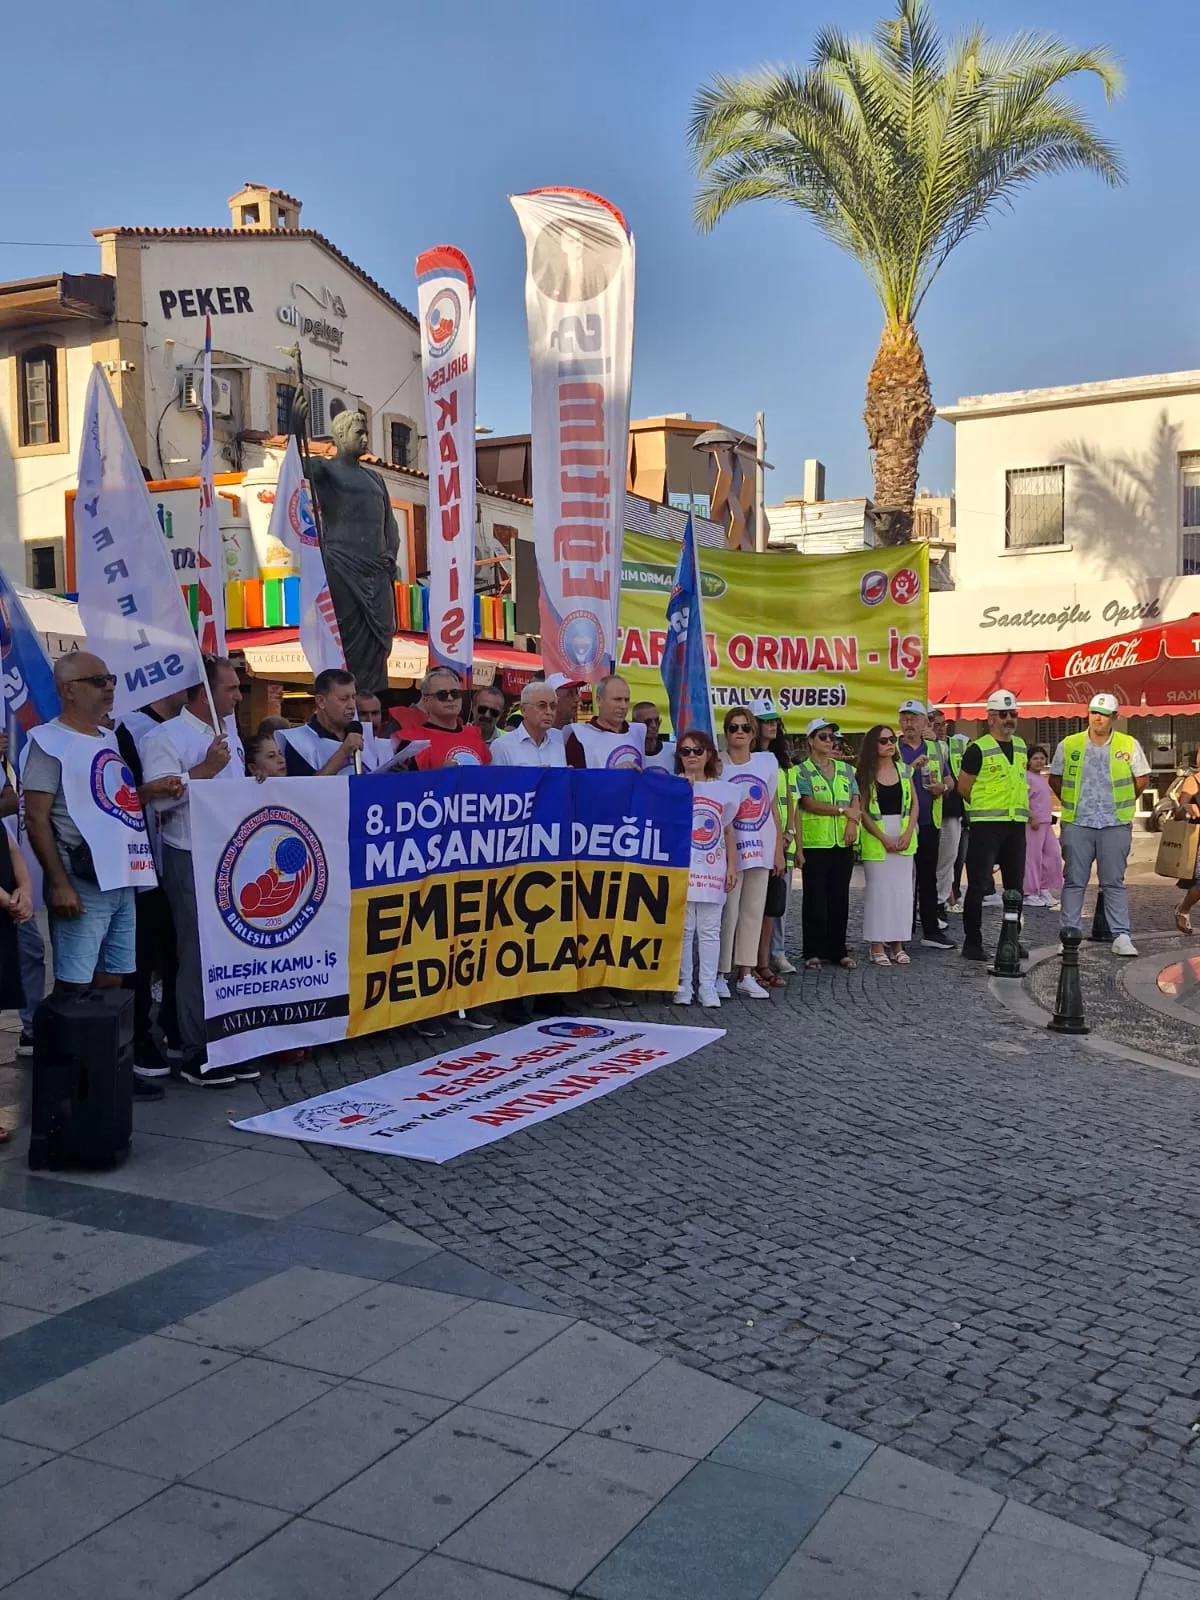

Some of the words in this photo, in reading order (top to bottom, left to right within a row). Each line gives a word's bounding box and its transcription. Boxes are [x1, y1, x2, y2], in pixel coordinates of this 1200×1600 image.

[159, 286, 254, 320] PEKER
[279, 304, 299, 328] ali
[301, 317, 345, 346] peker
[640, 571, 673, 587] ORMA
[1102, 598, 1160, 627] Optik
[58, 639, 80, 652] LA
[253, 655, 263, 663] LA
[265, 654, 305, 663] GELATERI
[728, 633, 859, 672] ORMAN
[888, 627, 922, 678] İŞ
[1065, 636, 1143, 678] Coca-Cola
[388, 659, 415, 669] ERIA
[779, 685, 848, 711] ŞUBESİ
[365, 803, 391, 836] 8.
[396, 790, 537, 832] DÖNEMDE
[365, 823, 561, 881] MASANIZIN
[571, 816, 670, 862] DEĞİL
[226, 912, 272, 945] BİRLEŞİK
[264, 918, 282, 927] 2008
[208, 958, 268, 984] BİRLEŞİK
[271, 954, 314, 975] KAMU
[324, 950, 337, 968] İŞ
[364, 938, 488, 1010] DEDİĞİ
[496, 933, 663, 977] OLACAK!
[215, 972, 329, 1001] KONFEDERASYONU
[222, 1001, 328, 1033] ANTALYA'DAYIZ
[418, 1051, 502, 1077] TÜM
[468, 1074, 612, 1128] ANTALYA
[369, 1120, 424, 1138] Tüm
